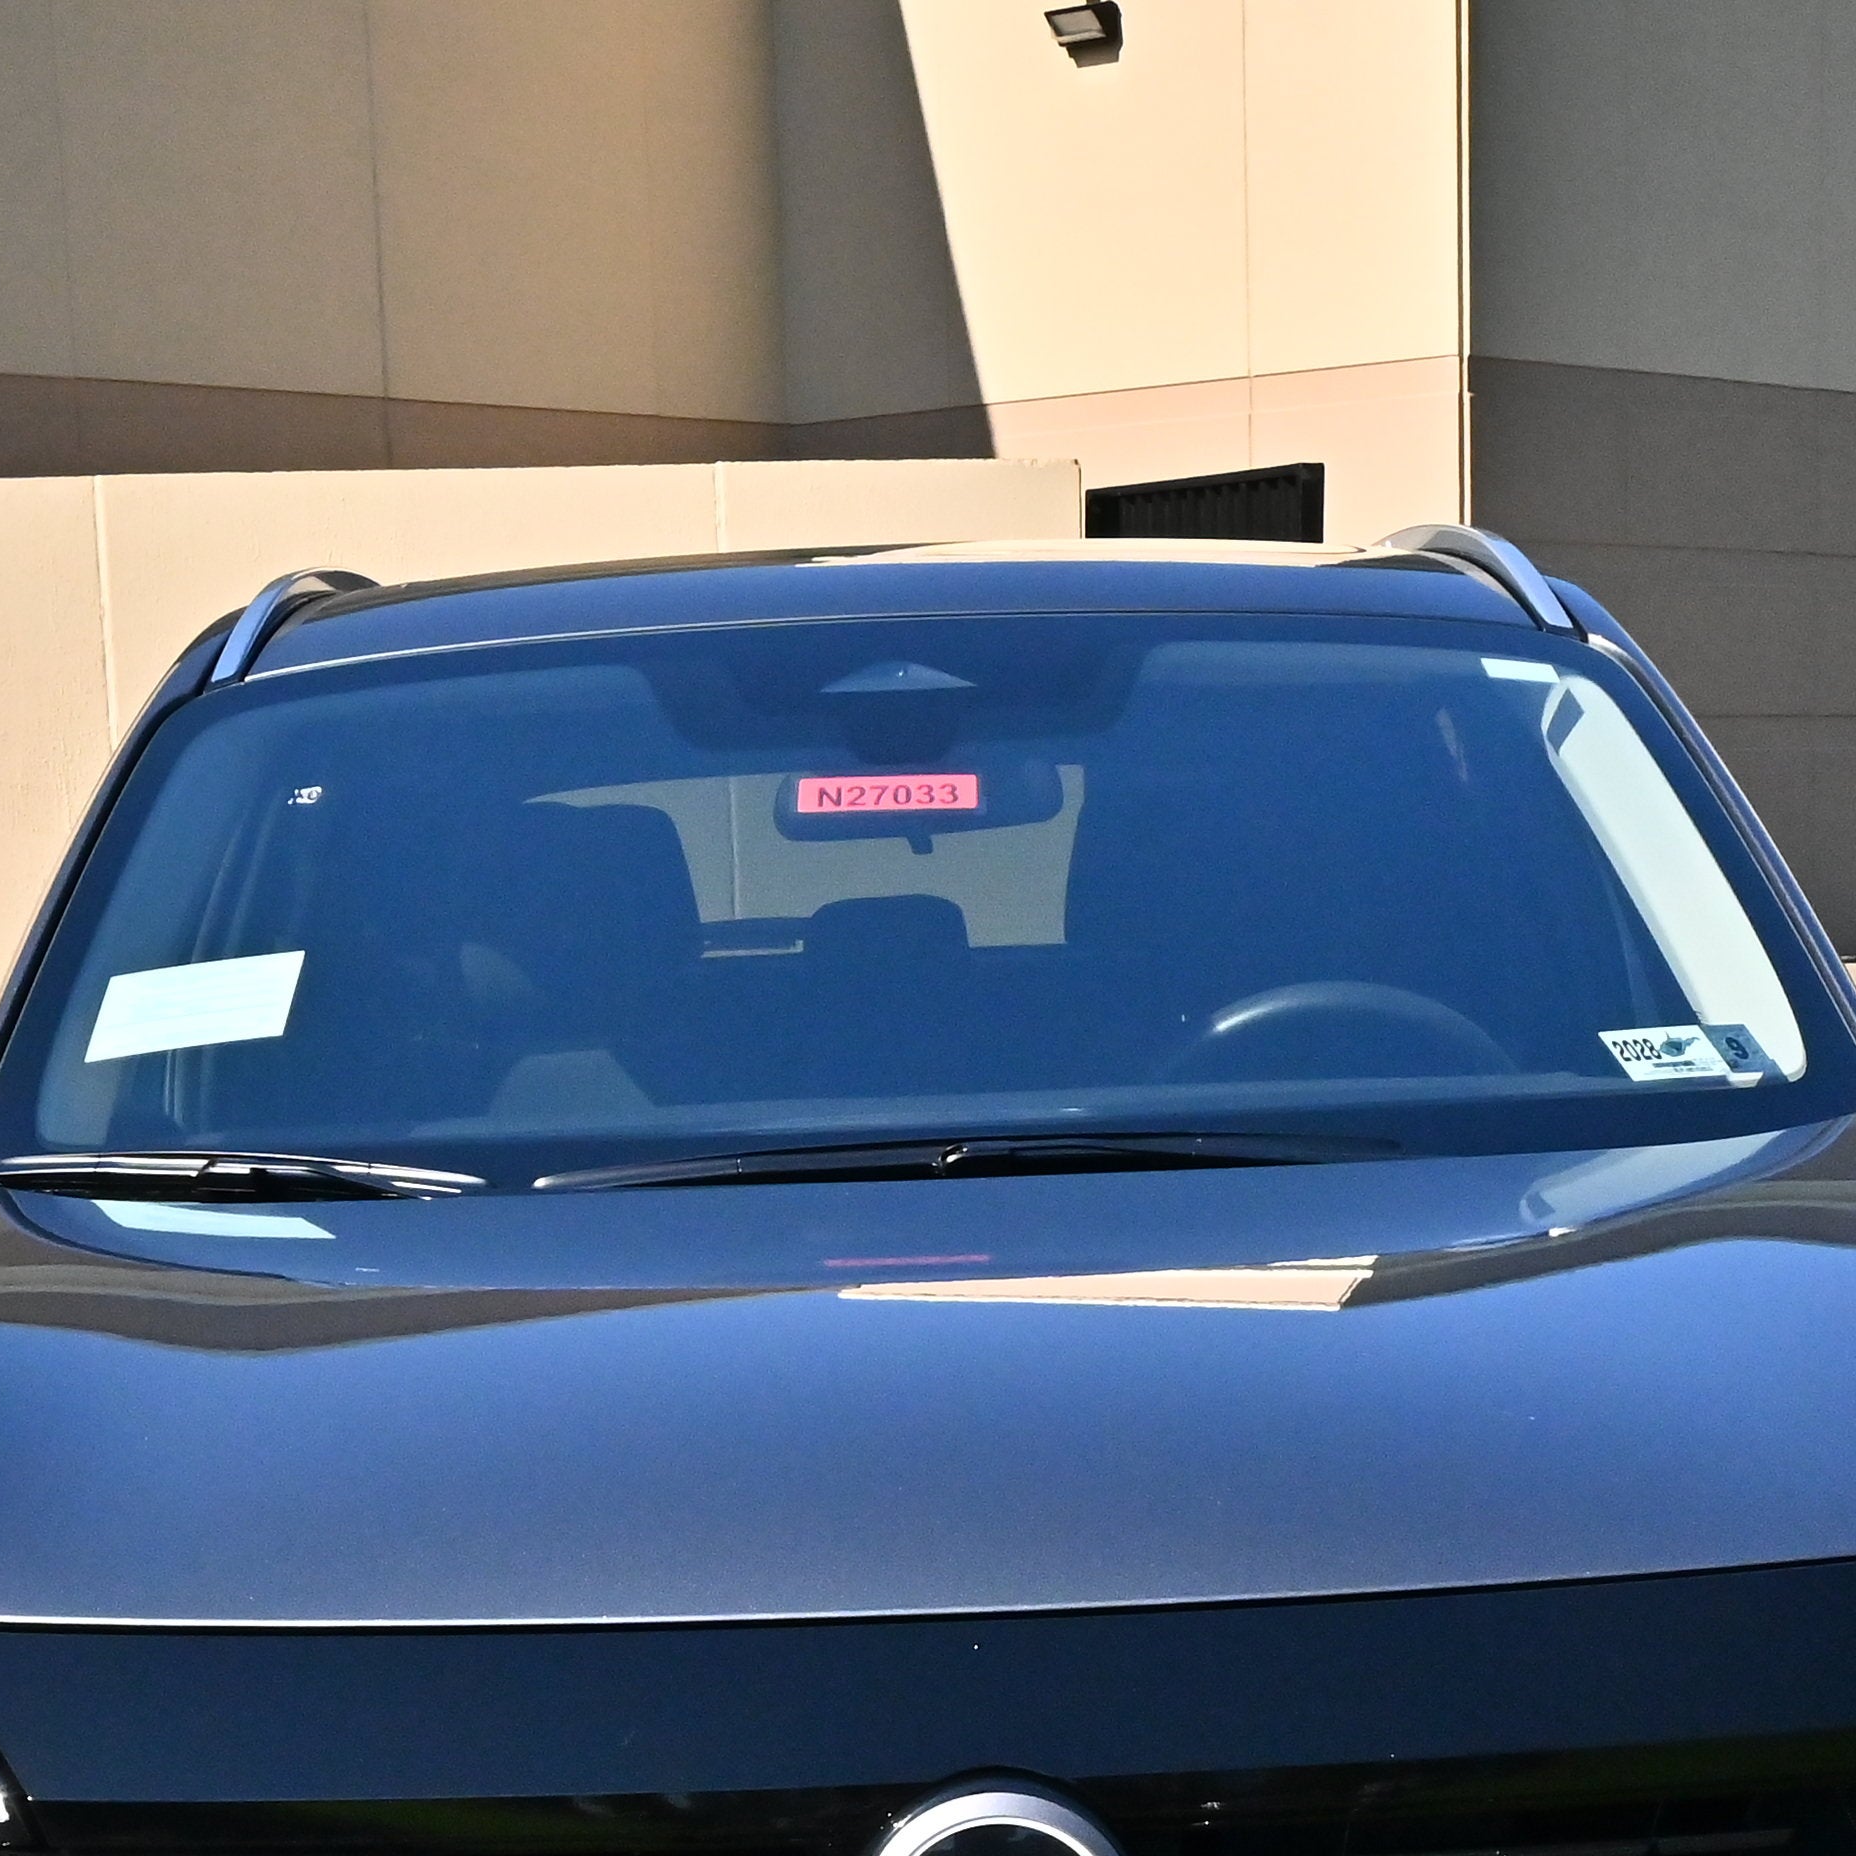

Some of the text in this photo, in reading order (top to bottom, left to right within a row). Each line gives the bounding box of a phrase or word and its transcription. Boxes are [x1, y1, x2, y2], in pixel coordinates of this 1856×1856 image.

[817, 784, 959, 807] N27033
[1612, 1038, 1662, 1062] 2028
[1725, 1037, 1749, 1060] 9
